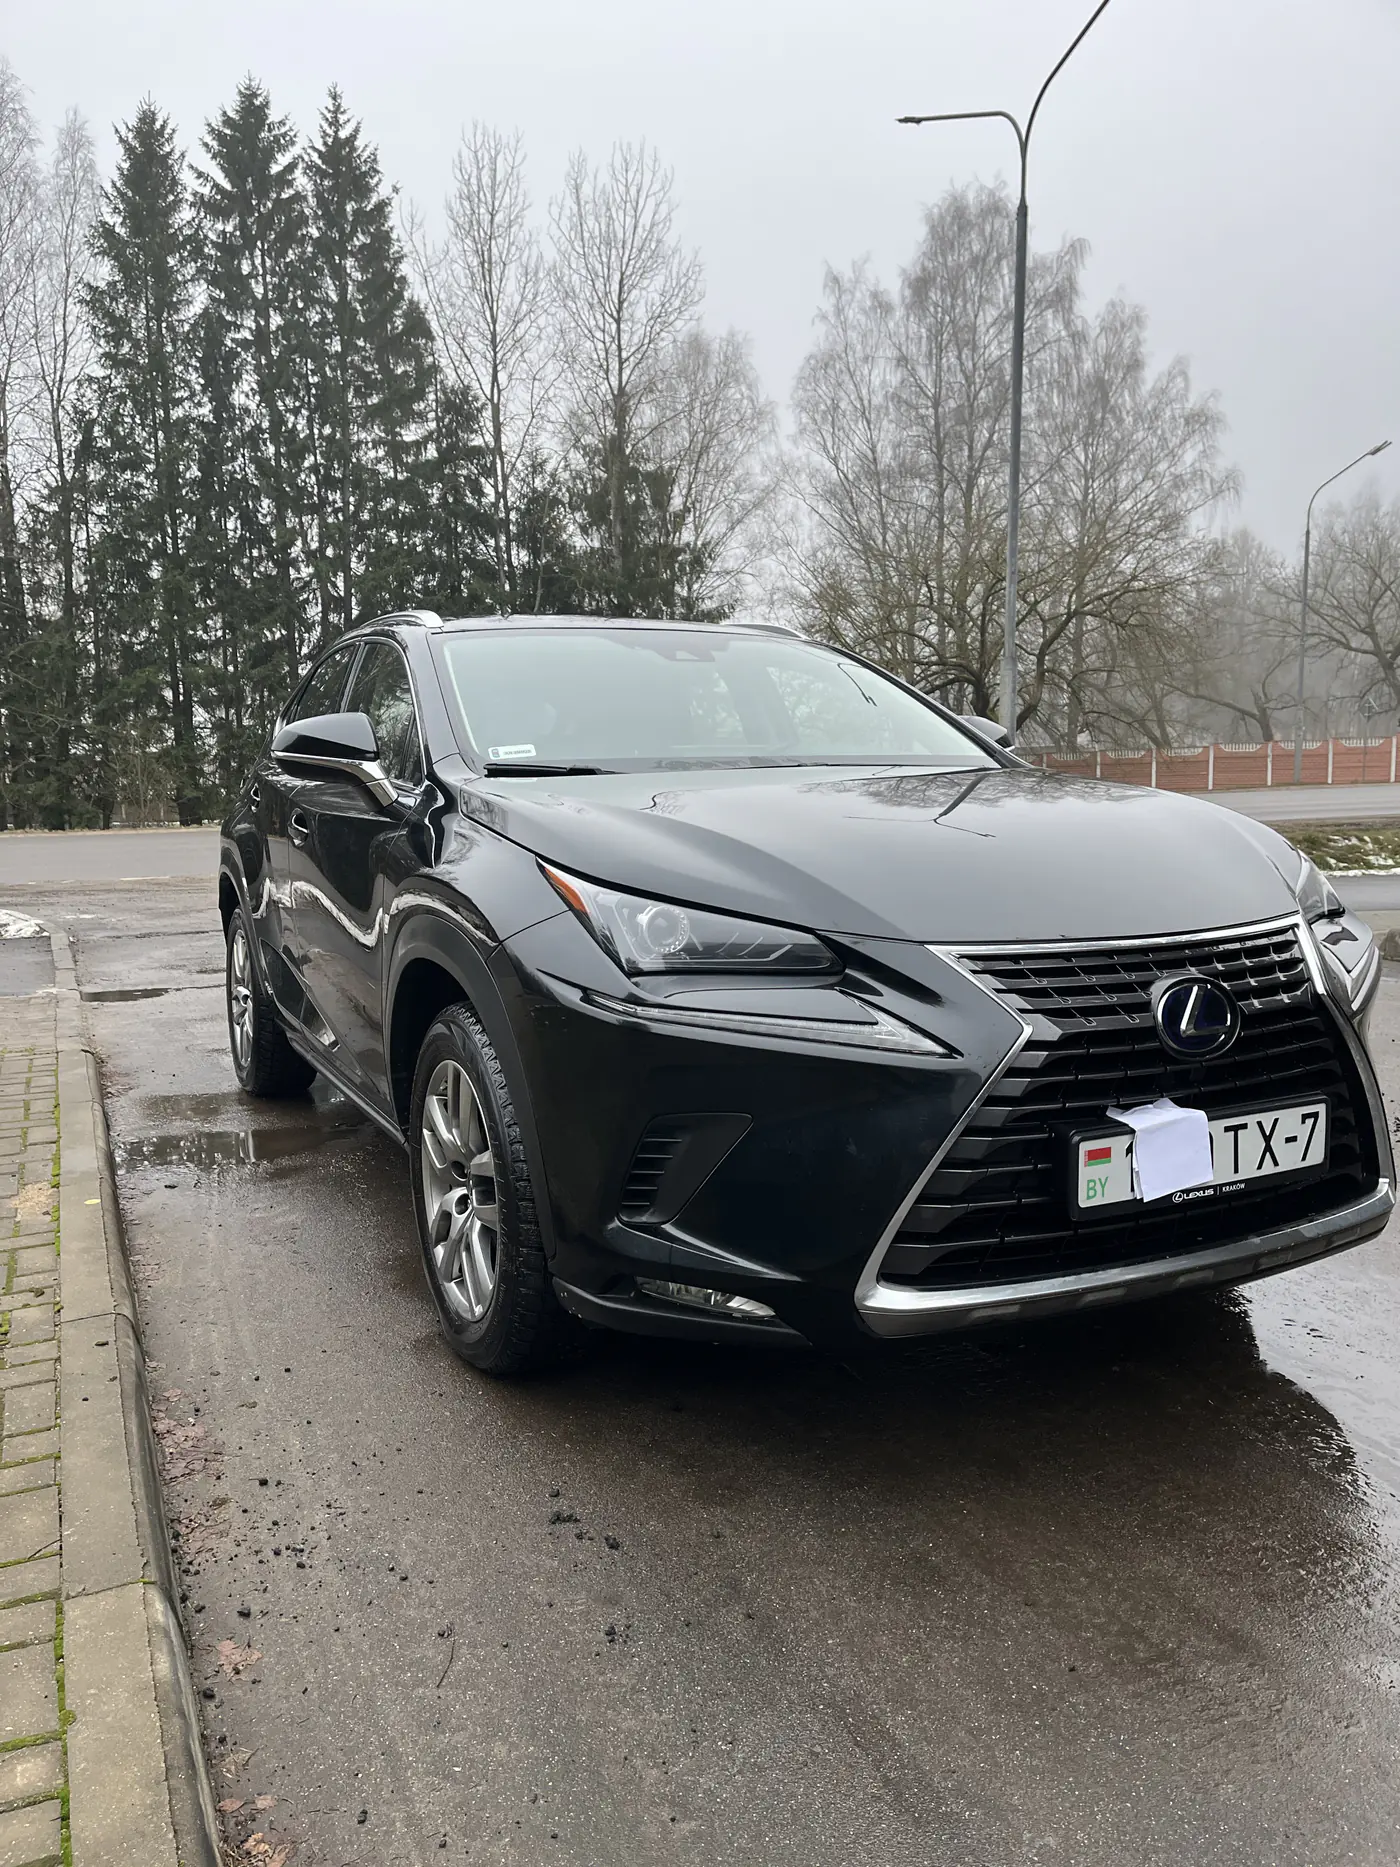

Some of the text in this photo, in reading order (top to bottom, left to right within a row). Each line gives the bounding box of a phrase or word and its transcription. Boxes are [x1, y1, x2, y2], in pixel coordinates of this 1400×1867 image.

[1223, 1110, 1320, 1174] TX-7
[1086, 1176, 1109, 1200] BY
[1183, 1188, 1215, 1200] LEXUS
